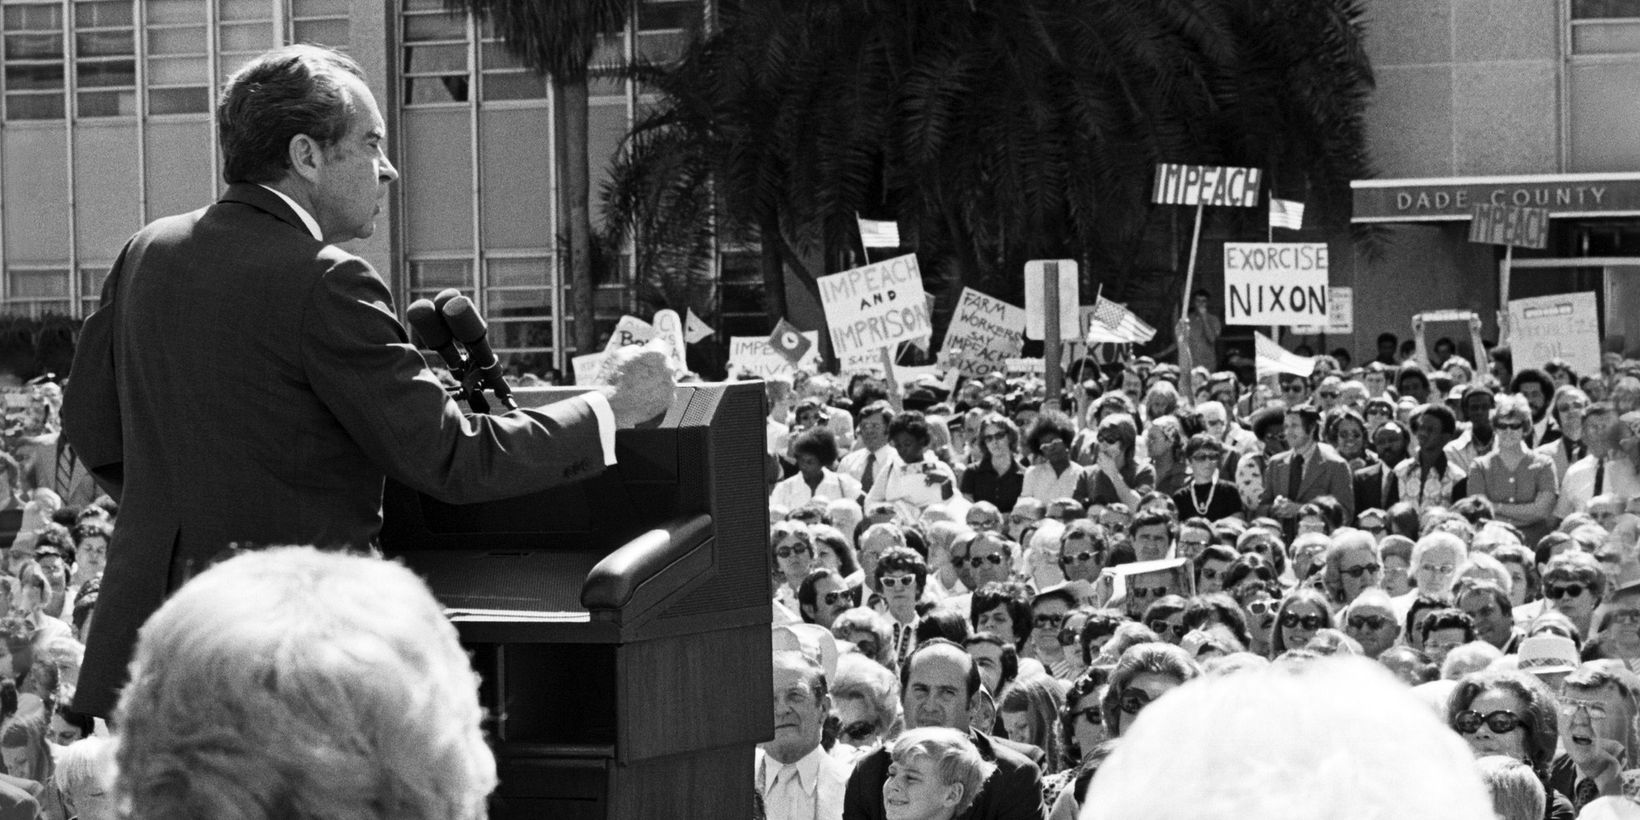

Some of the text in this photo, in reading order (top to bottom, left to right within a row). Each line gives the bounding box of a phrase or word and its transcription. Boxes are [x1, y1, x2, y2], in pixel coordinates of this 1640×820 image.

[1152, 163, 1262, 207] IMPEACH
[1397, 187, 1606, 210] DADE COUNTY
[1468, 204, 1549, 249] IMPEACH
[1227, 246, 1328, 270] EXORCISE
[821, 256, 921, 304] IMPEACH
[860, 290, 897, 311] AND
[963, 292, 1005, 320] FARM
[1229, 283, 1327, 317] NIXON
[832, 303, 932, 353] IMPRISON
[966, 331, 993, 346] SAY
[1059, 341, 1130, 366] IXON
[958, 360, 1006, 376] IXON
